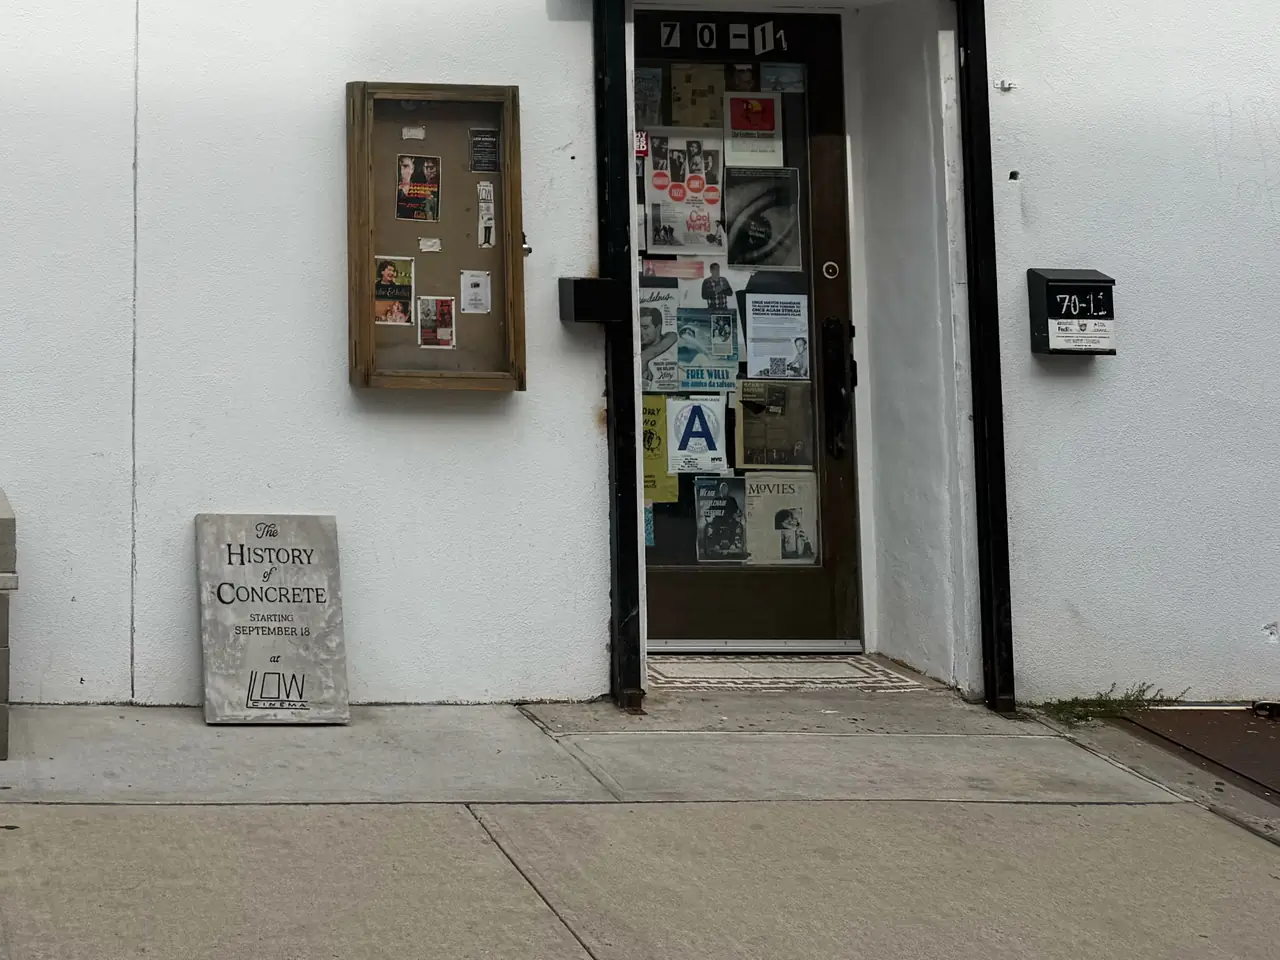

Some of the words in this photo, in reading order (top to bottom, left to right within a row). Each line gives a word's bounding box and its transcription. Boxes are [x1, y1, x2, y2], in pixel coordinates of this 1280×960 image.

[686, 369, 705, 380] FREE
[677, 405, 718, 451] A
[748, 483, 796, 495] MOVIES
[255, 522, 278, 538] The
[226, 543, 314, 566] HISTORY
[262, 567, 277, 582] of
[216, 582, 327, 605] CONCRETE
[249, 613, 294, 622] STARTING
[234, 625, 298, 636] SEPTEMBER
[300, 626, 311, 636] 18
[269, 655, 282, 663] at
[246, 670, 310, 710] LOW
